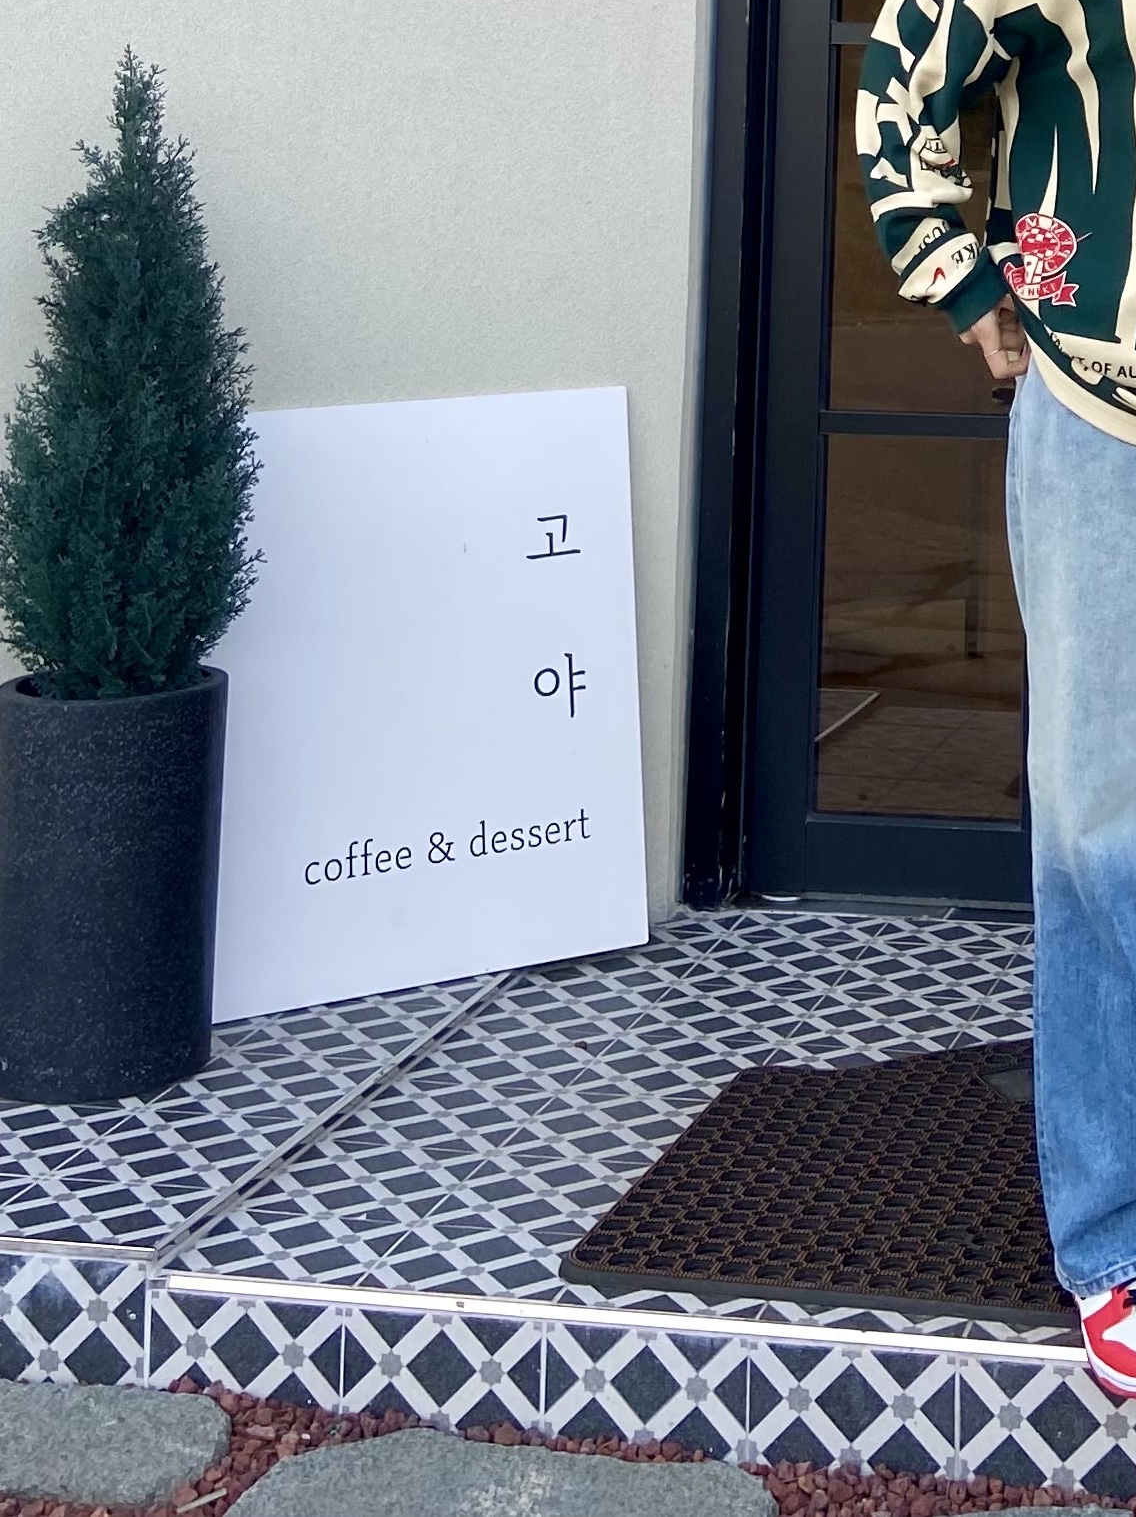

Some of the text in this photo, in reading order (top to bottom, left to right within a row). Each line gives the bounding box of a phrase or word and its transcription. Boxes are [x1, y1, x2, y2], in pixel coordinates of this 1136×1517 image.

[1091, 361, 1113, 375] OF
[304, 808, 592, 885] coffee & dessert
